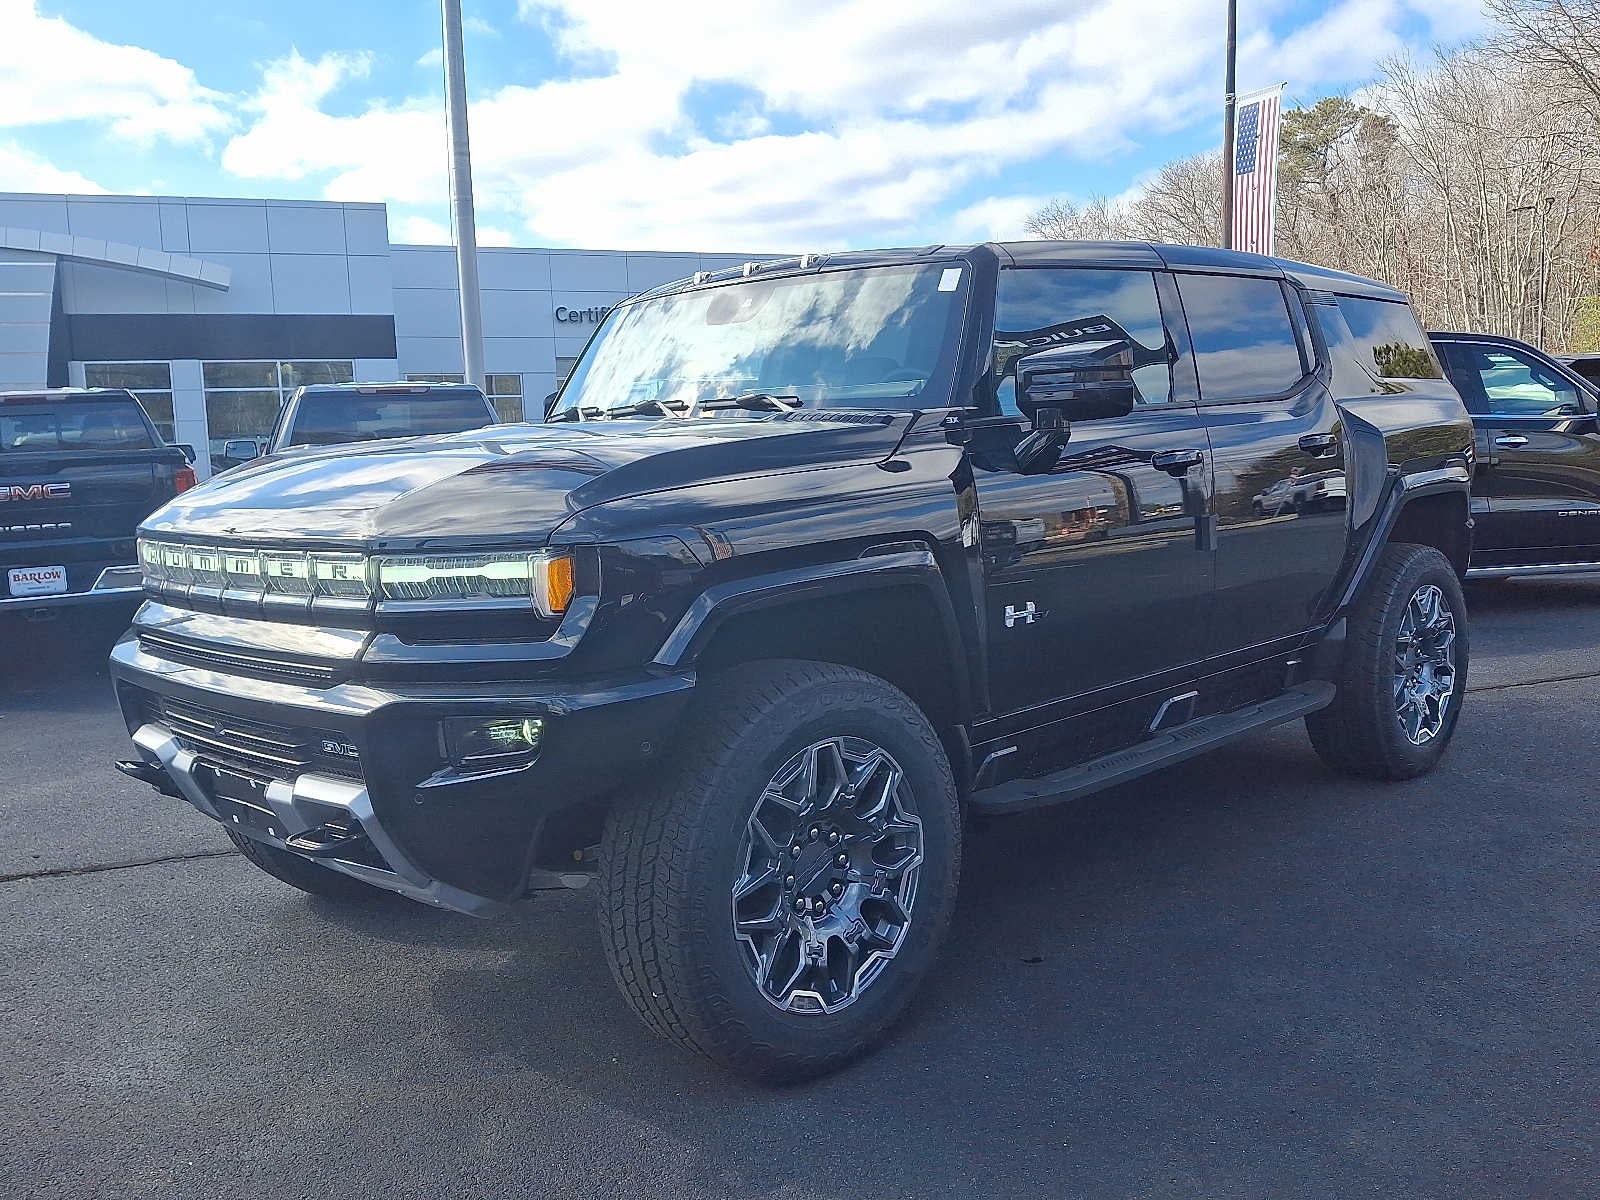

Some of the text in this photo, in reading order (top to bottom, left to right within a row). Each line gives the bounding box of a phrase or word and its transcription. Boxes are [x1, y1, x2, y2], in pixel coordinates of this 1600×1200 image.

[555, 306, 611, 323] Certif
[13, 570, 62, 584] BARLOW
[321, 740, 360, 758] GMC
